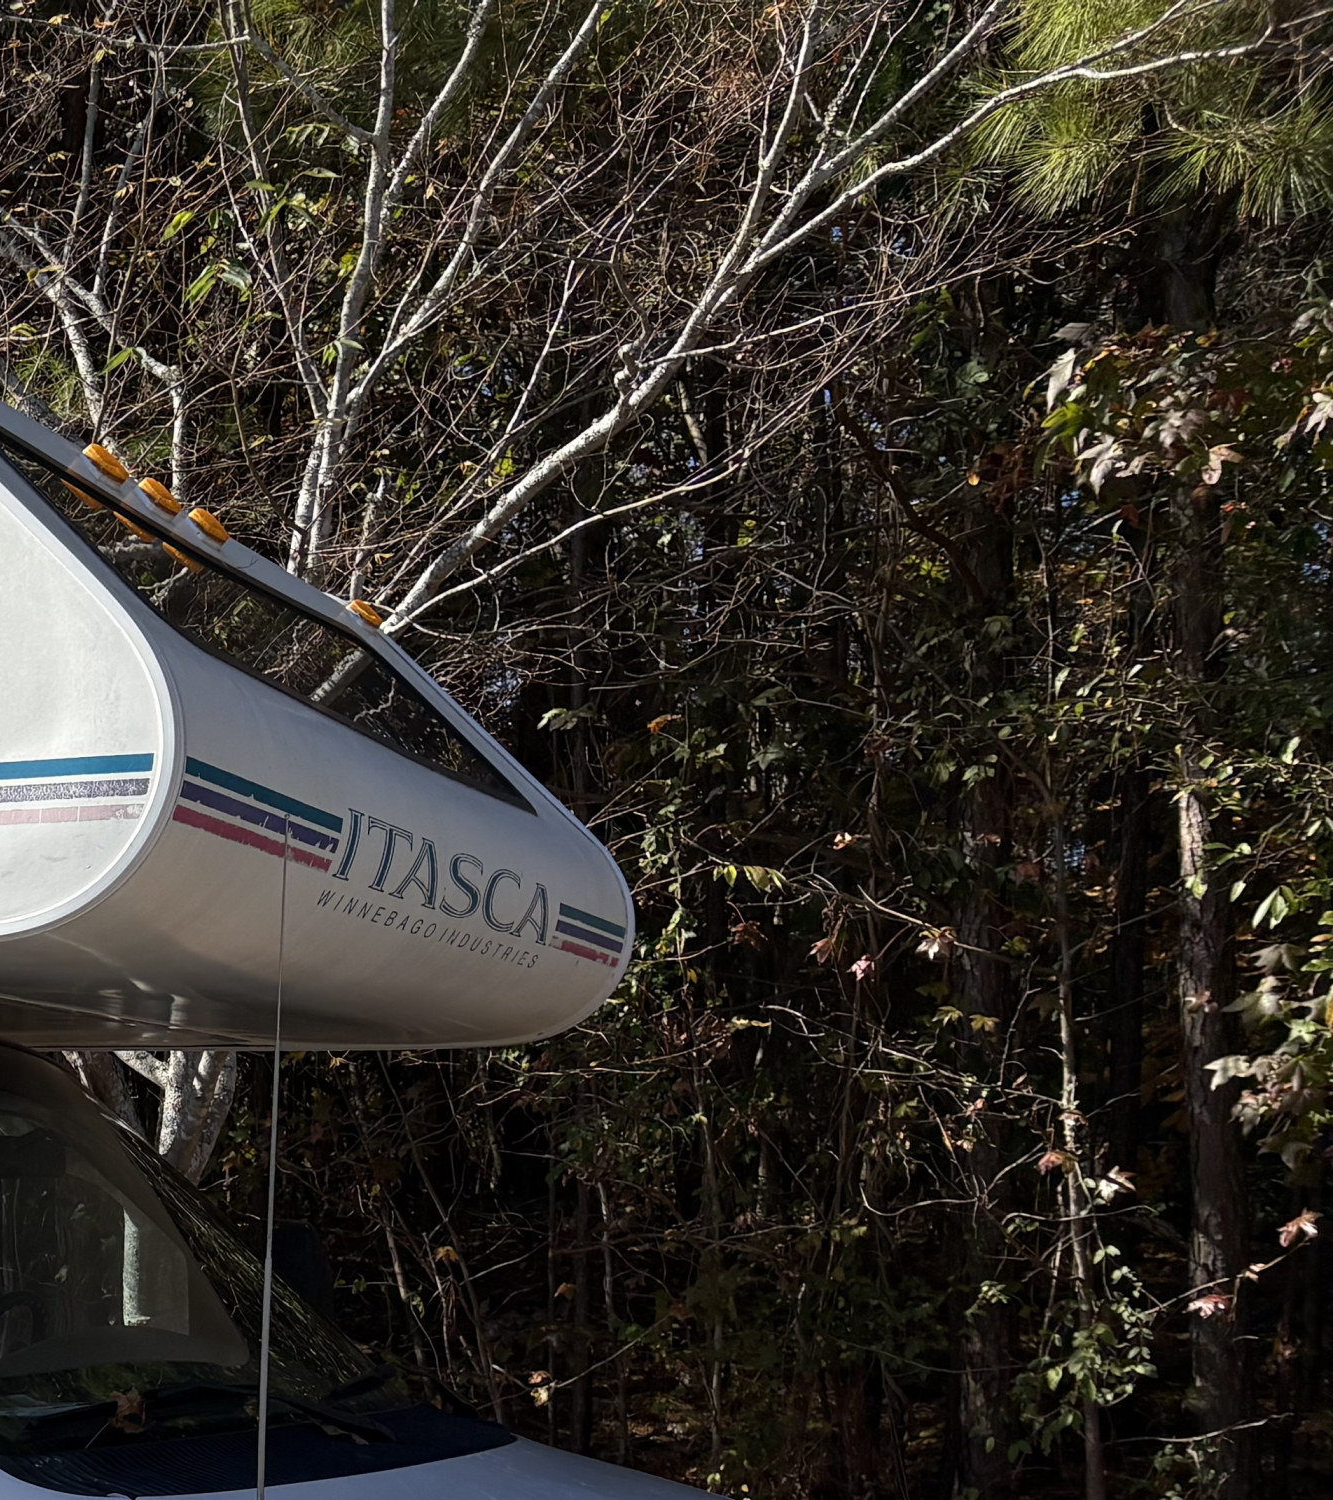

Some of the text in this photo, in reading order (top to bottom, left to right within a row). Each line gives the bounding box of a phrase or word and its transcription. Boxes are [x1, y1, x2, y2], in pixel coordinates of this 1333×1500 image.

[316, 888, 540, 969] WINNEBAGO INDUSTRIES
[331, 807, 551, 947] ITASCA
